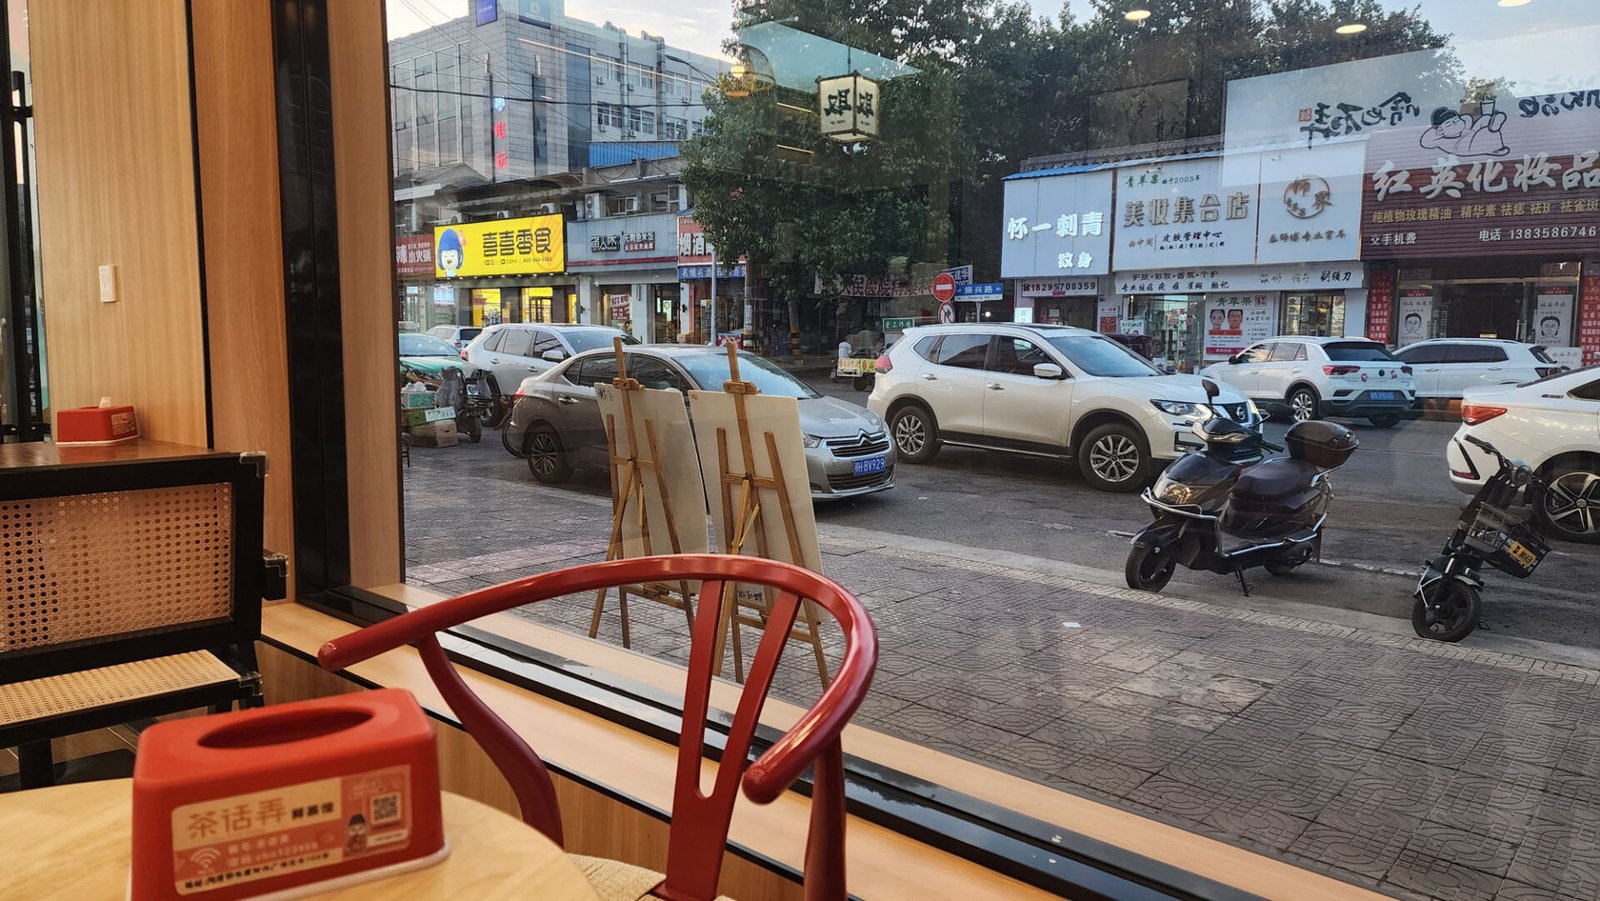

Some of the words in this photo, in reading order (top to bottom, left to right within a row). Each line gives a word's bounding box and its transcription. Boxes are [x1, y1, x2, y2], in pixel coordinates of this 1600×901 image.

[1372, 150, 1600, 201] 红英化妆品
[1007, 211, 1104, 240] 怀一刺青
[1123, 191, 1250, 228] 美妆集合店
[1461, 204, 1496, 219] 精华素
[1479, 228, 1501, 242] 电话
[1509, 225, 1600, 240] 1383586746
[188, 797, 286, 839] 茶话弄
